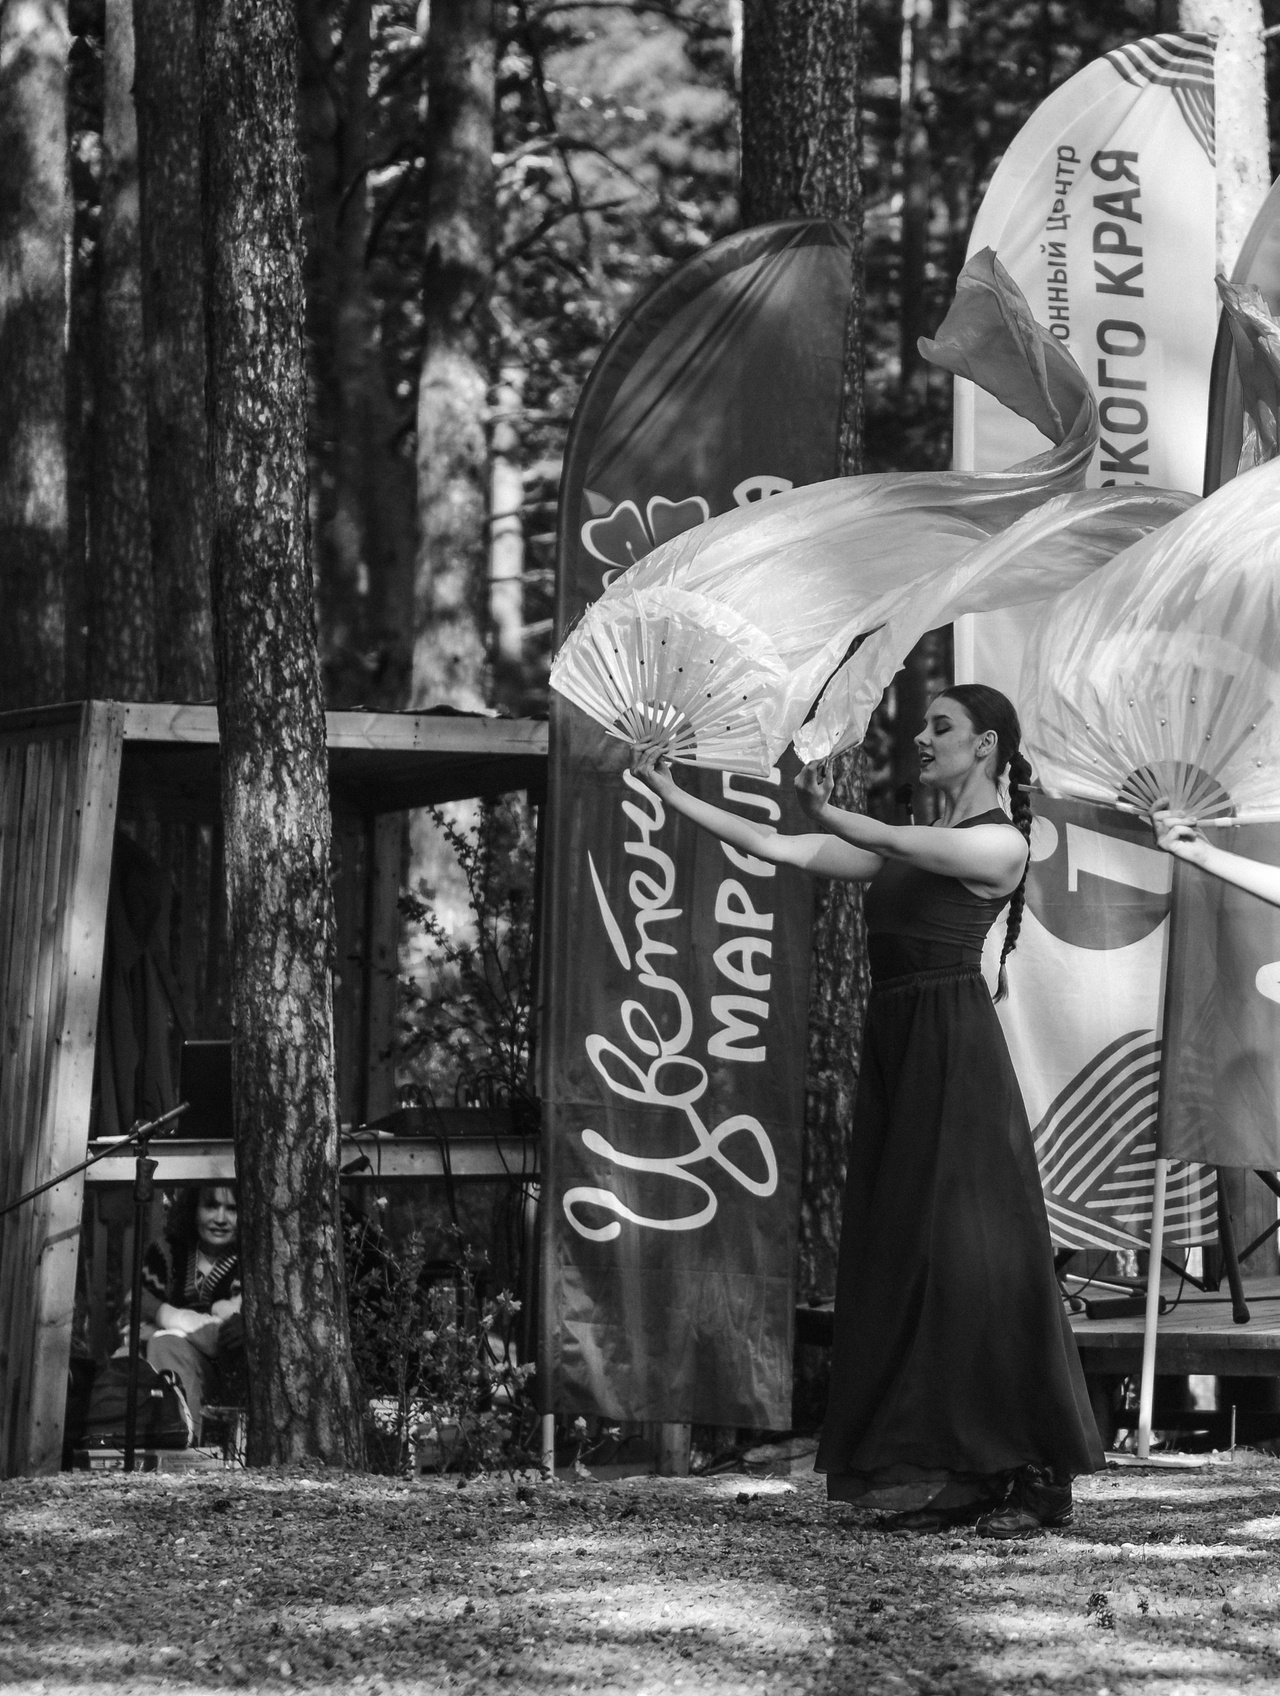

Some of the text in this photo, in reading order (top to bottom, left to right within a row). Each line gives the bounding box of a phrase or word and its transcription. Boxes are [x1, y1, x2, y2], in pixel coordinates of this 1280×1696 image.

[1040, 242, 1071, 349] онный
[1090, 149, 1150, 488] КОГО КРАЯ
